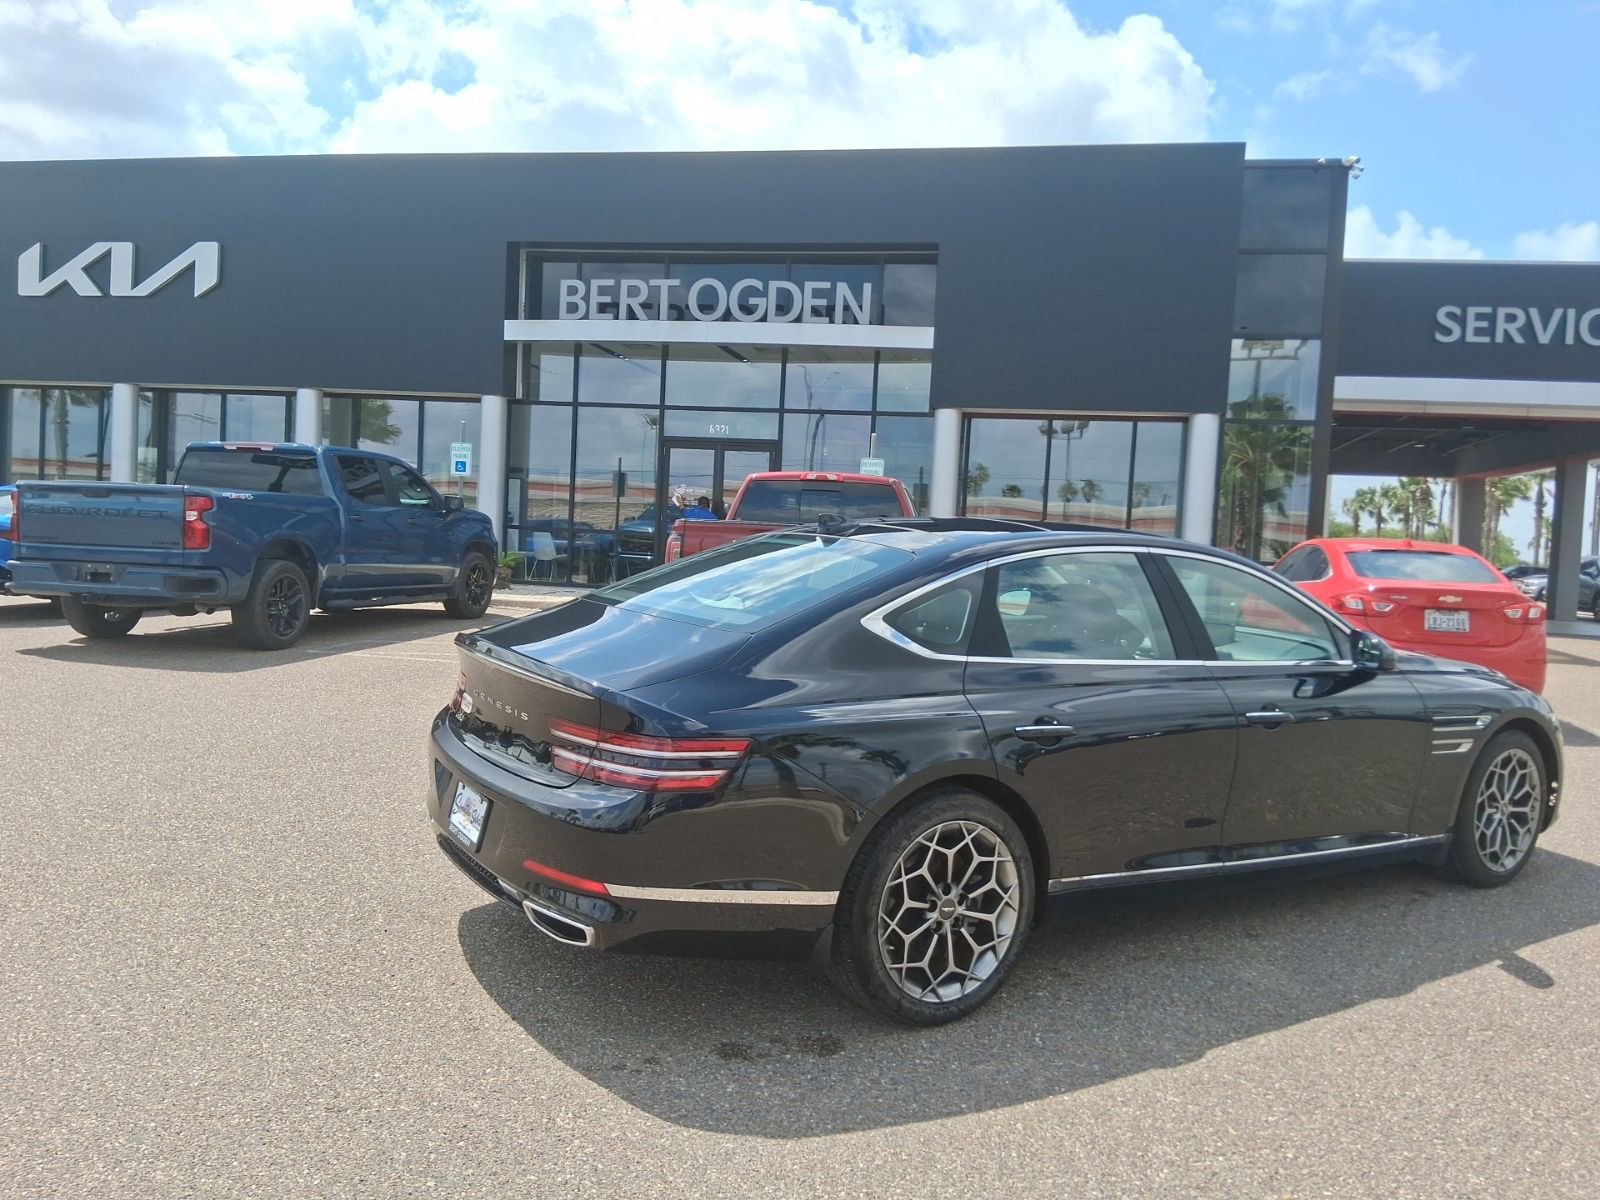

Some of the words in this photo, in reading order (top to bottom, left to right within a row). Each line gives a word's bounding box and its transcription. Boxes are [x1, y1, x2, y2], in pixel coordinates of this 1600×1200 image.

[18, 241, 220, 298] KIA
[558, 278, 681, 321] BERT
[687, 277, 873, 326] OGDEN
[1434, 304, 1600, 347] SERVIC
[473, 689, 529, 721] GENESIS
